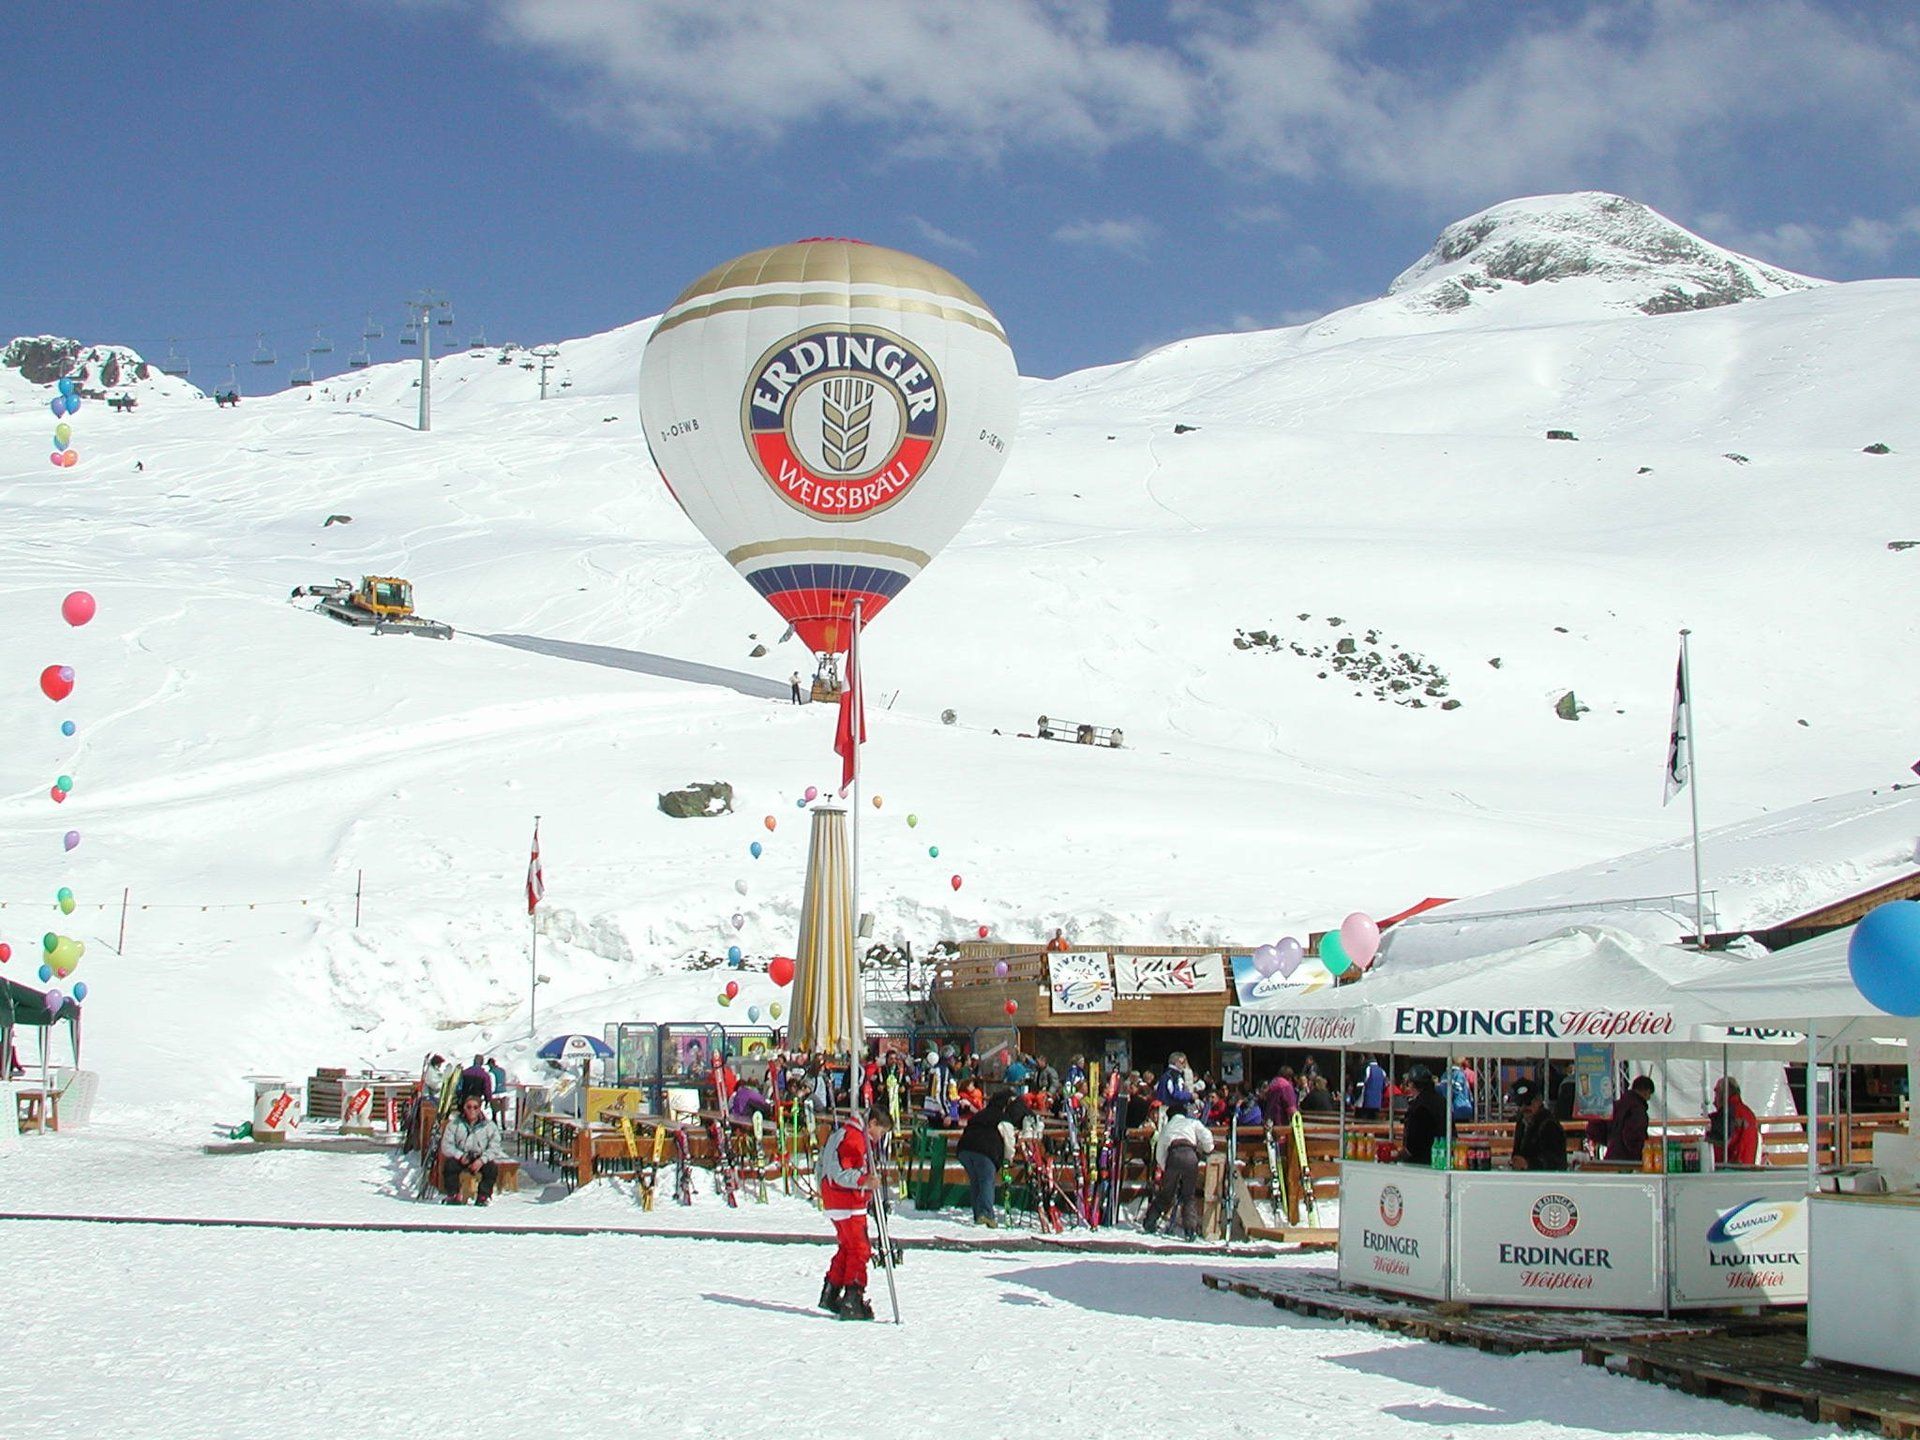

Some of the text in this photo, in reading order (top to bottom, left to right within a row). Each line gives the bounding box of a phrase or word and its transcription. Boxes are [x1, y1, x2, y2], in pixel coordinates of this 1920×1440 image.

[752, 336, 936, 422] ERDINGER
[779, 459, 911, 508] WEISSBRÄU
[1231, 1010, 1356, 1042] ERDINGER Weißbier
[1394, 1007, 1675, 1040] ERDINGER Weißbier
[1729, 1213, 1778, 1231] SAMNAUN
[1363, 1229, 1420, 1259] ERDINGER
[1499, 1243, 1613, 1269] ERDINGER
[1520, 1270, 1593, 1290] Weißbier
[1726, 1271, 1784, 1290] Weißbier
